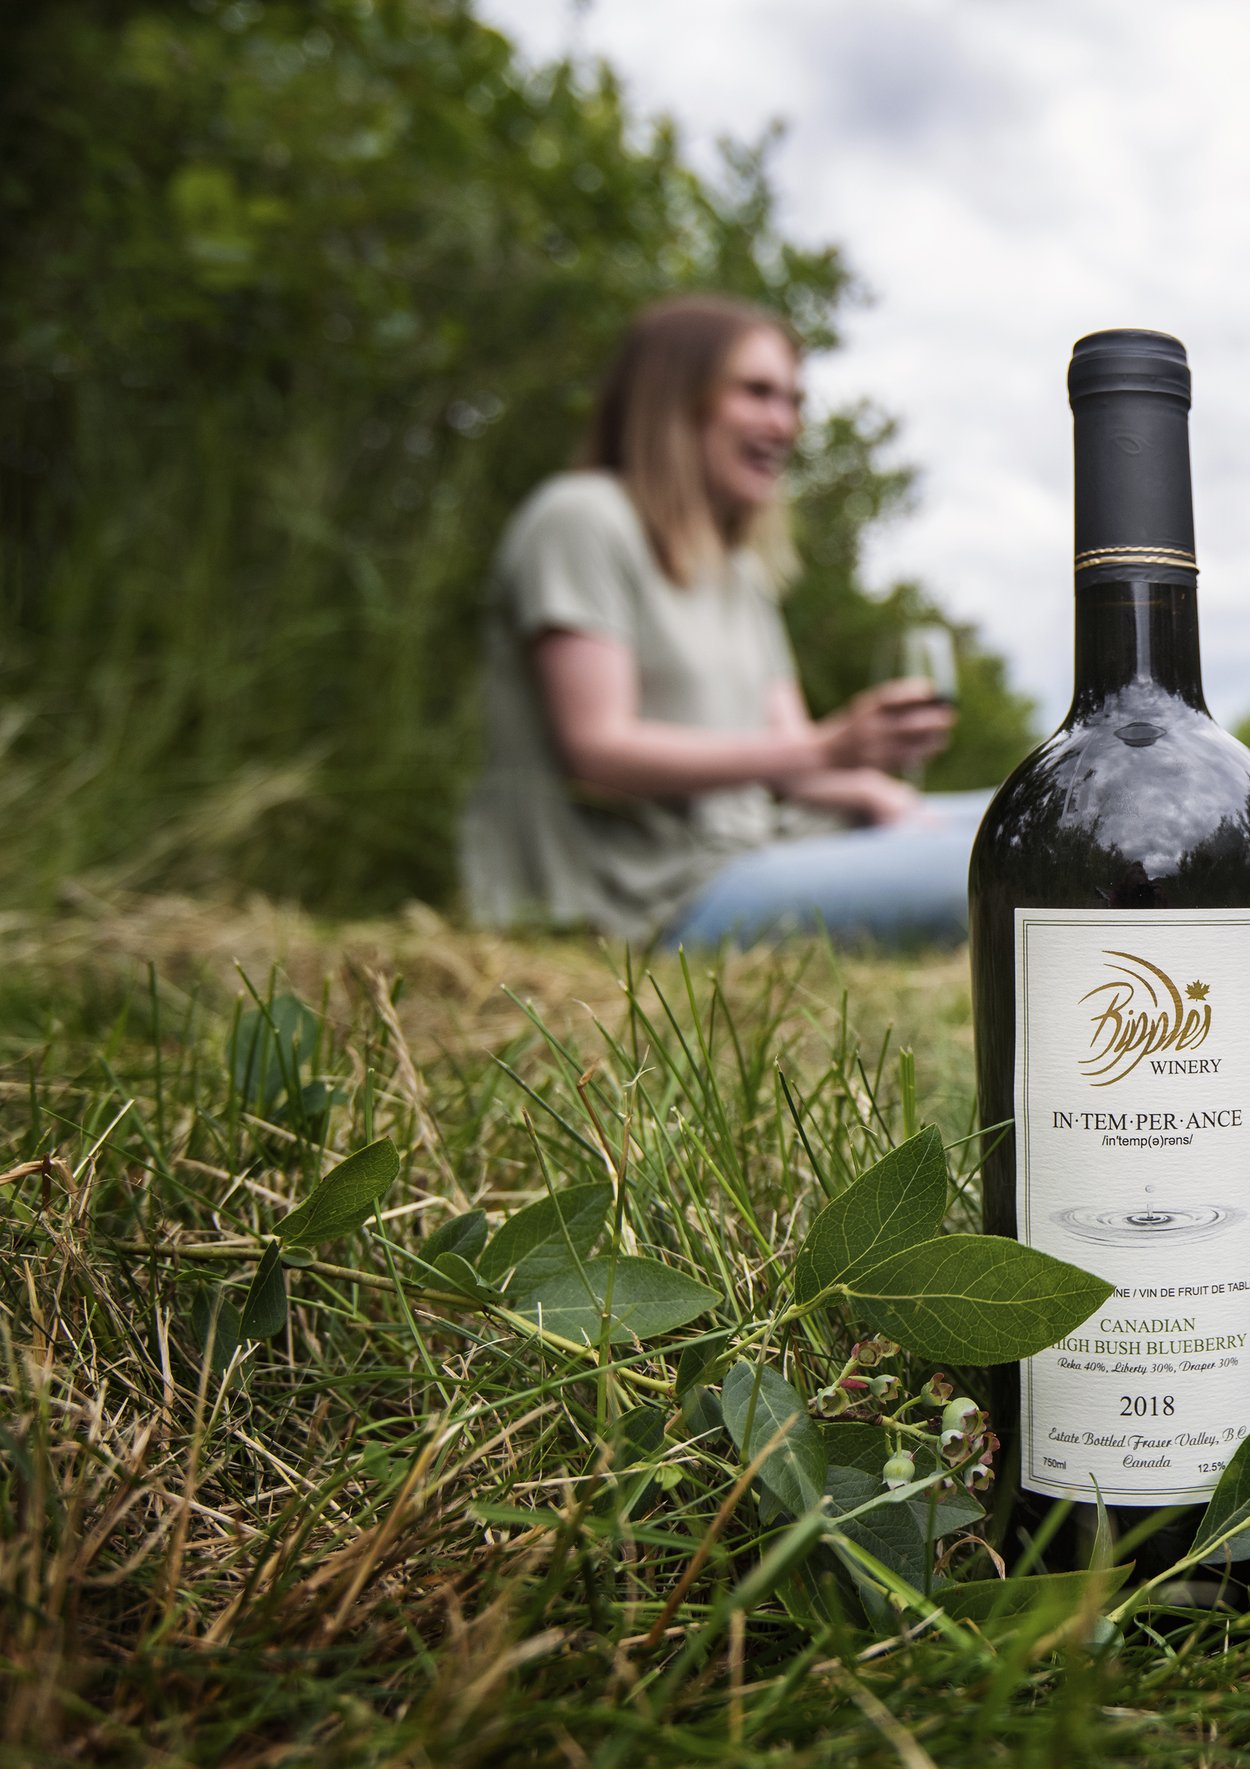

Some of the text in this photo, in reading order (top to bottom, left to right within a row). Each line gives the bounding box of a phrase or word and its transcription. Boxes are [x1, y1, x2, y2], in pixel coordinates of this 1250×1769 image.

[1077, 981, 1212, 1087] Ripples
[1150, 1058, 1222, 1075] WINERY
[1139, 1288, 1157, 1298] VIN
[1160, 1288, 1175, 1298] DE
[1178, 1285, 1209, 1297] FRUIT
[1211, 1283, 1225, 1294] DE
[1100, 1317, 1196, 1333] CANADIAN
[1094, 1340, 1141, 1355] BUSH
[1146, 1333, 1248, 1355] BLUEBERRY
[1057, 1357, 1239, 1375] Reka 40%, Liberty 30%, Draper 30%
[1119, 1395, 1175, 1416] 2018
[1048, 1427, 1080, 1444] Estate
[1081, 1432, 1126, 1448] Bottled
[1127, 1434, 1173, 1451] Fraser
[1174, 1432, 1220, 1446] Valley,
[1043, 1456, 1067, 1470] 750ml
[1122, 1454, 1172, 1469] Canada
[1198, 1461, 1226, 1473] 12.5%
